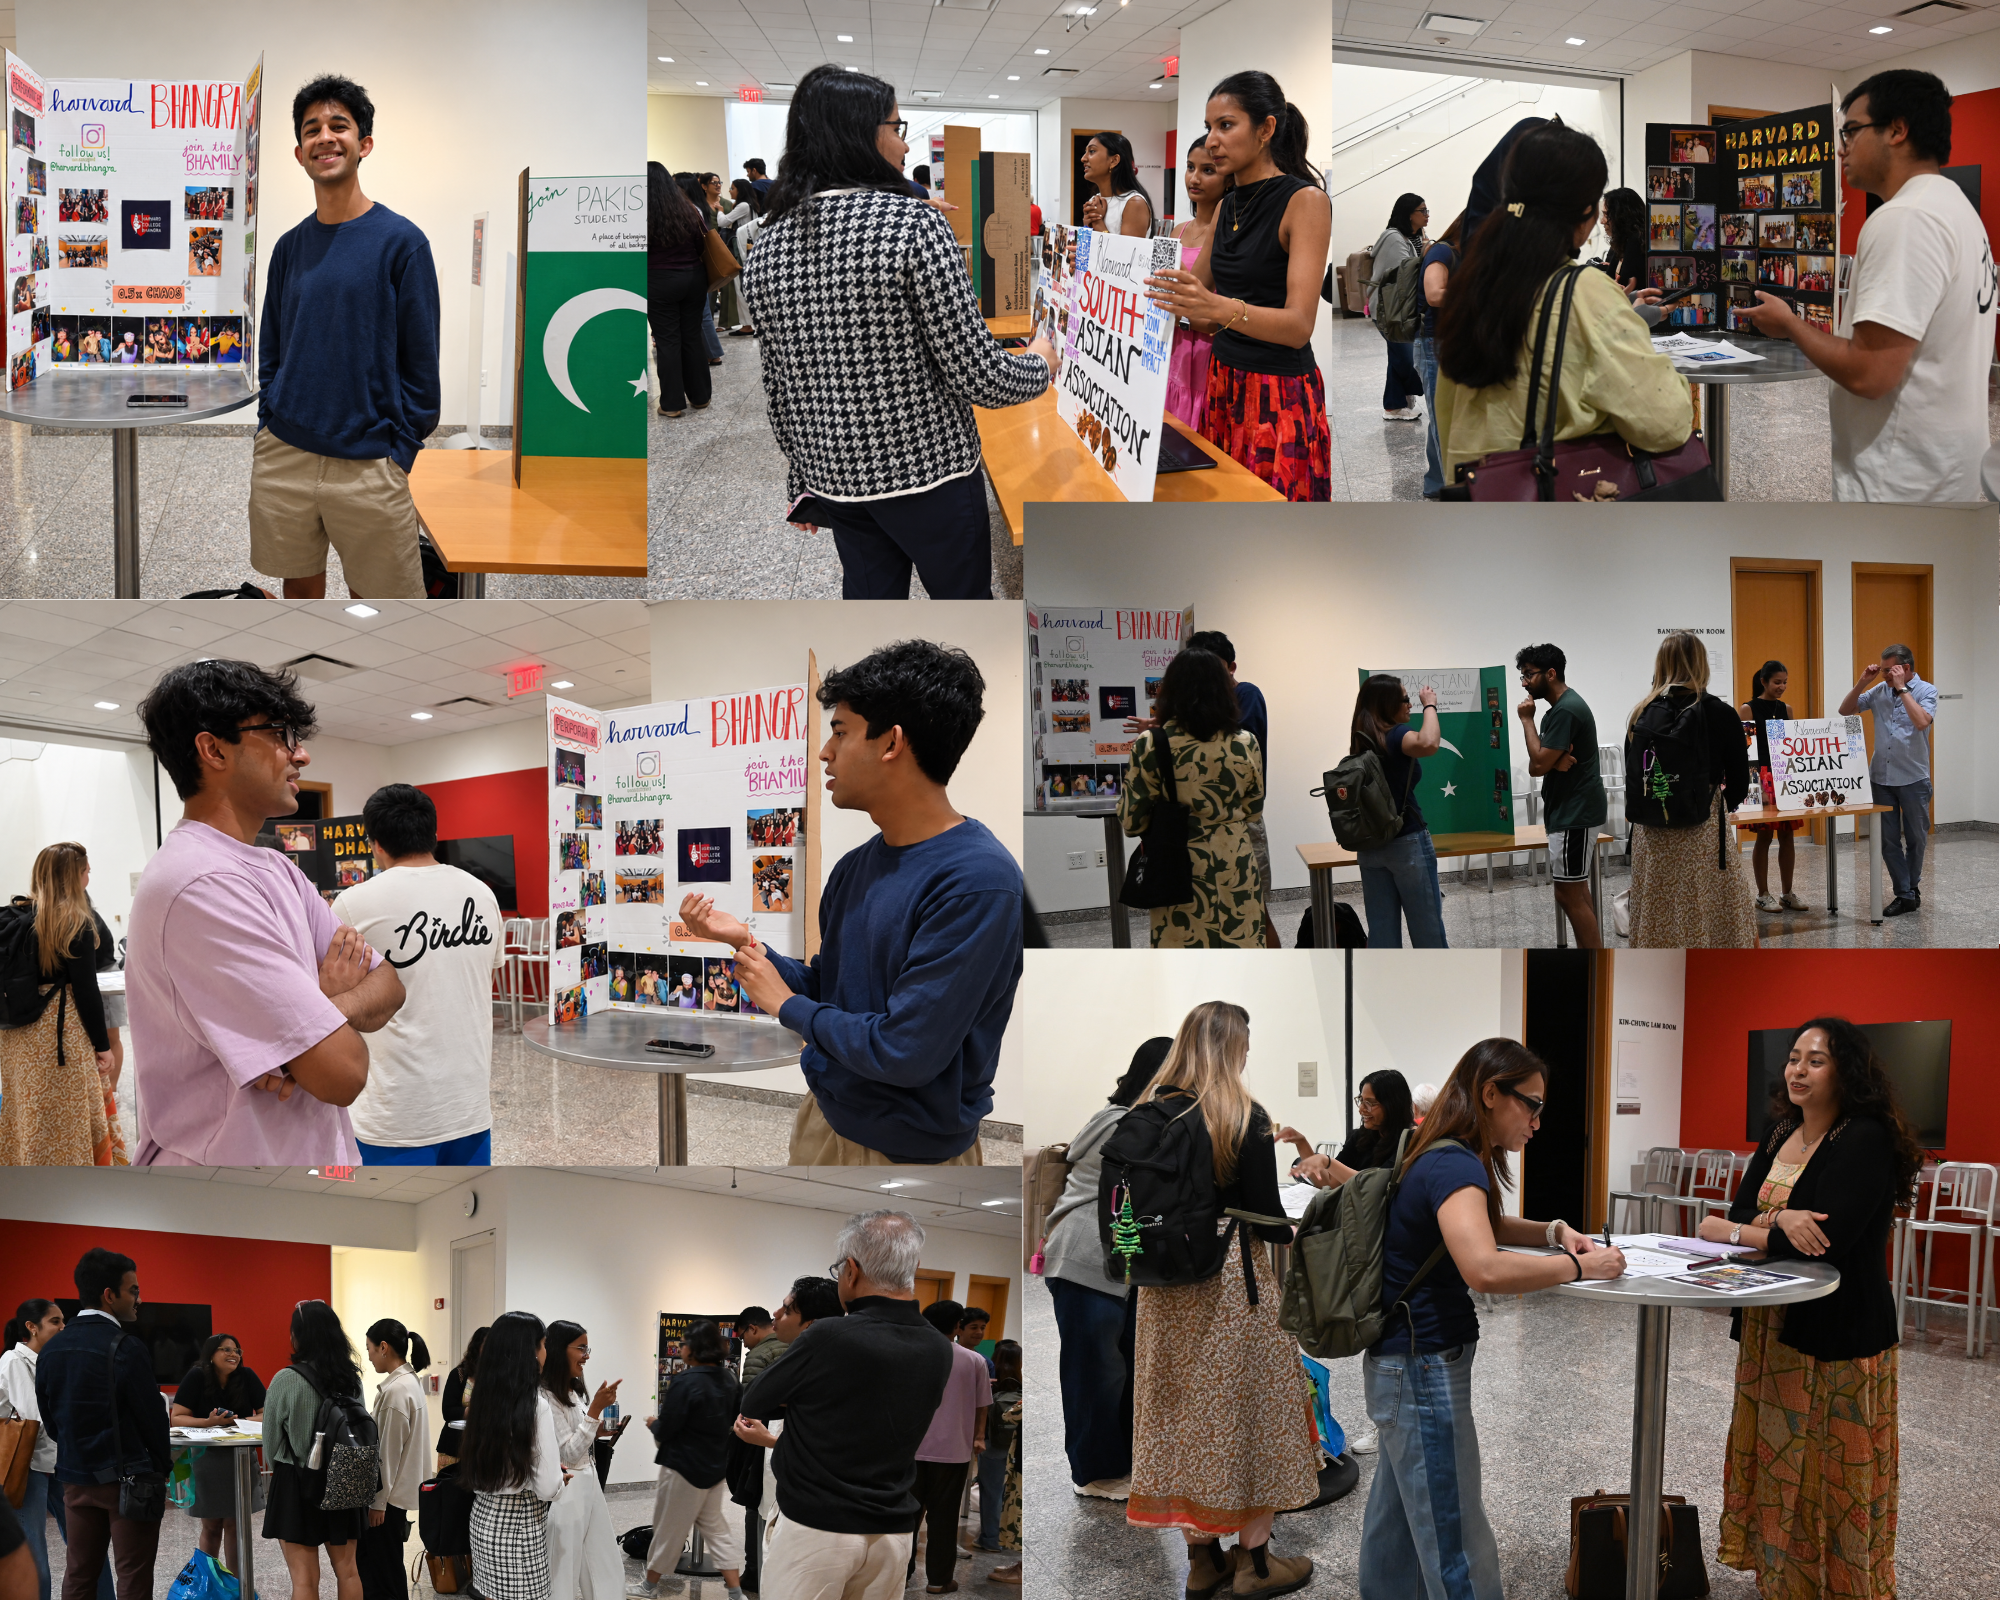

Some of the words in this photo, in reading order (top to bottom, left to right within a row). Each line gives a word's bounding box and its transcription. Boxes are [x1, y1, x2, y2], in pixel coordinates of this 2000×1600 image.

[48, 83, 144, 113] harvard
[151, 83, 242, 130] BHANGRA
[1725, 120, 1820, 150] HARVARD
[59, 144, 94, 158] follow
[97, 146, 111, 161] us!
[182, 138, 204, 158] join
[212, 141, 233, 152] the
[186, 153, 243, 171] BHAMILY
[577, 184, 648, 212] PAKIS
[574, 213, 628, 225] STUDENTS
[592, 233, 597, 241] A
[599, 233, 614, 243] place
[615, 232, 621, 240] of
[622, 233, 647, 242] belonging
[609, 241, 616, 249] of
[1095, 235, 1138, 285] Harvard
[118, 287, 143, 300] 0.5x
[146, 286, 182, 300] CHAOS
[1079, 270, 1144, 338] SOUTH
[1075, 316, 1142, 385] ASIAN
[1064, 360, 1150, 465] ASSOCIATION
[1040, 610, 1112, 630] harvard
[1116, 610, 1181, 641] BHANGRA
[1049, 649, 1077, 659] follow
[514, 668, 538, 692] EXIT
[1402, 673, 1471, 690] PAKISTANI
[556, 716, 588, 739] PERFORM
[605, 704, 701, 745] harvard
[1794, 721, 1837, 736] Harvard
[1781, 737, 1846, 756] SOUTH
[780, 754, 804, 768] the
[1785, 753, 1849, 775] ASIAN
[615, 775, 649, 789] follow
[652, 774, 666, 789] us!
[1780, 776, 1864, 796] ASSOCIATION
[384, 897, 493, 968] Birdie
[1618, 1018, 1650, 1028] KIN-CHUNG
[1651, 1021, 1661, 1029] LAM
[1662, 1023, 1677, 1031] ROOM
[665, 1328, 684, 1338] DHA
